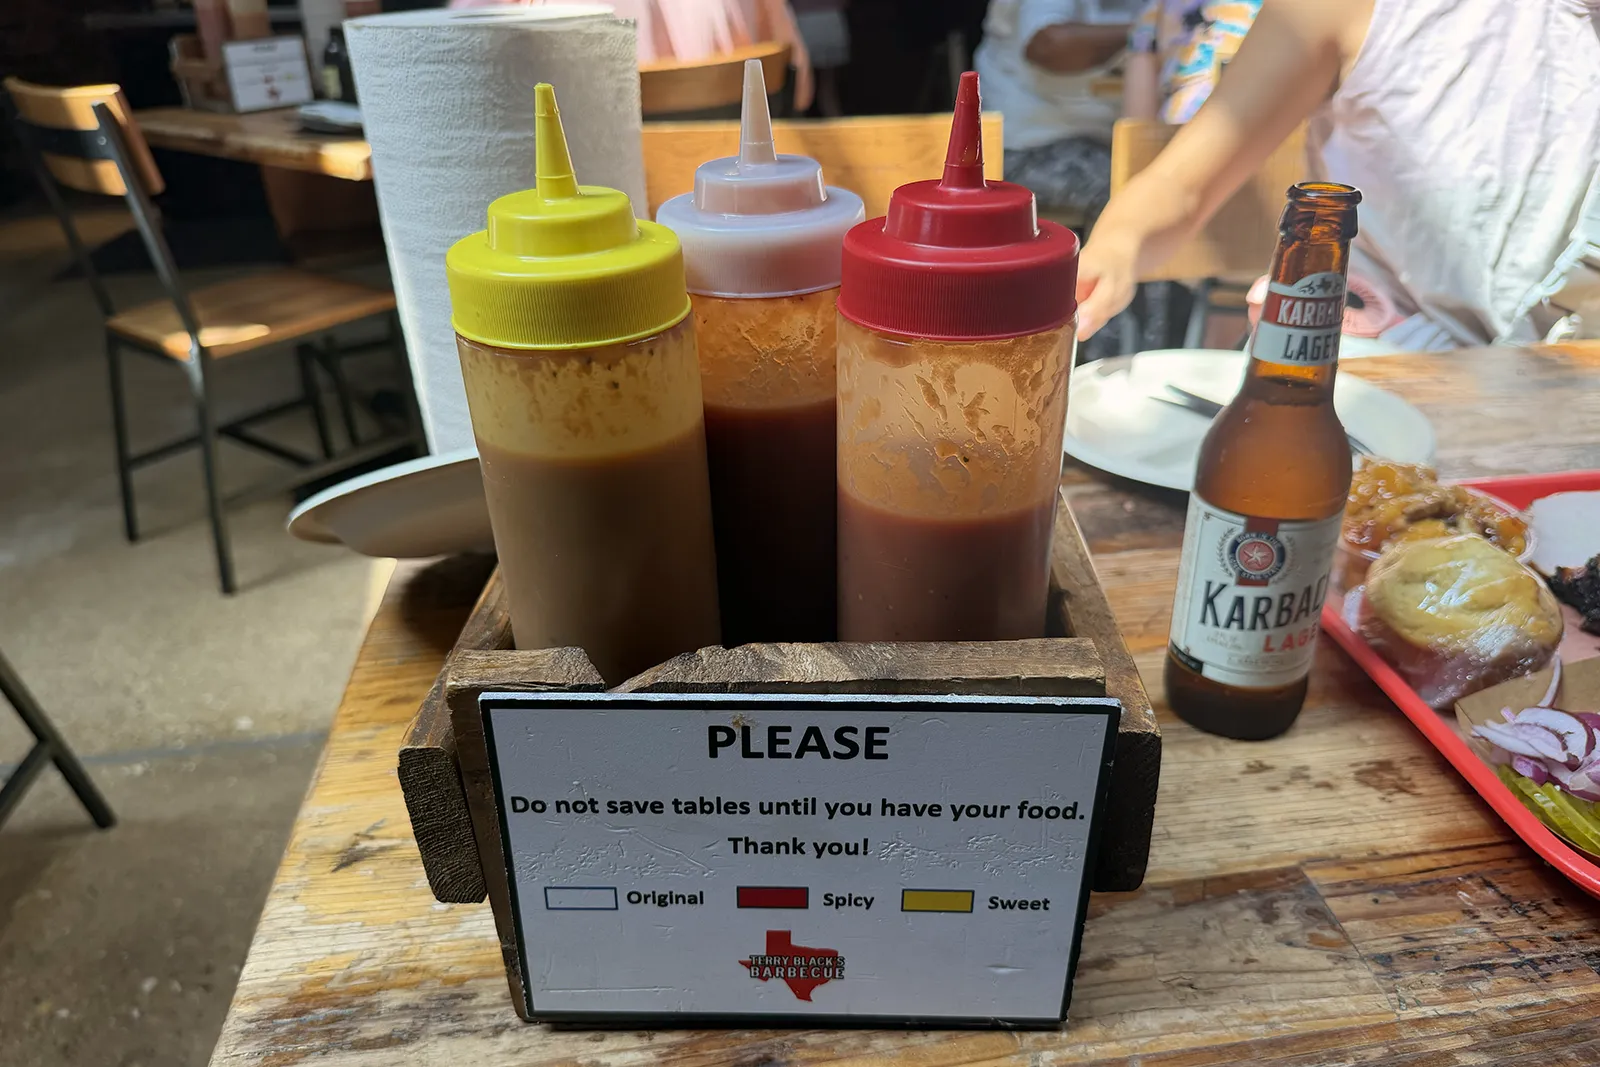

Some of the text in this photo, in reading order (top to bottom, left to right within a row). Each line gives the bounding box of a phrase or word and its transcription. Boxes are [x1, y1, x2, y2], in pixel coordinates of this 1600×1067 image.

[1199, 573, 1327, 632] KARBAC
[707, 724, 890, 761] PLEASE
[510, 796, 1086, 822] Do not save tables until you have your food.
[727, 836, 869, 859] Thank you!
[626, 890, 705, 908] Original
[822, 893, 875, 911] Spicy
[987, 895, 1051, 911] Sweet
[749, 955, 846, 968] TERRY BLACK'S
[749, 966, 845, 979] BARBECUE
